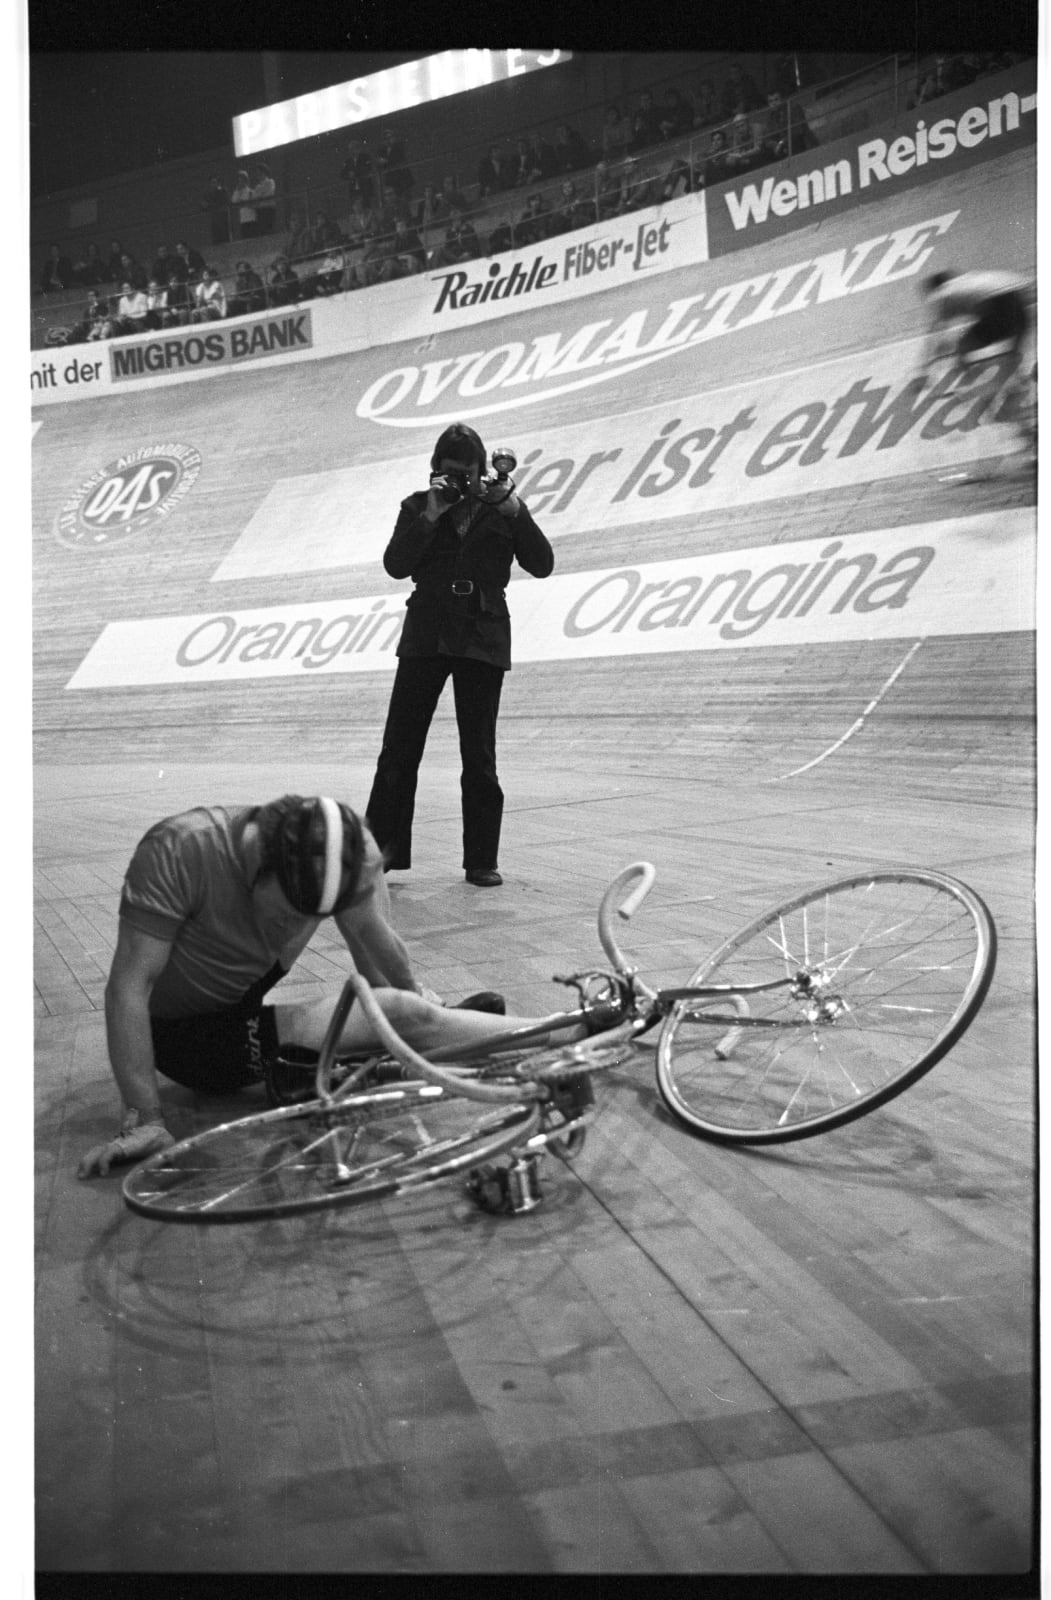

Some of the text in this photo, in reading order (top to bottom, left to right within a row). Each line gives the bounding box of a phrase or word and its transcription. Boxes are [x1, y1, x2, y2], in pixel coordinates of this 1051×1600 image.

[724, 92, 1036, 231] Wenn Reisen-
[355, 209, 960, 419] OVOMALTINE
[432, 217, 671, 315] Raichle Fiber-Jet
[64, 358, 102, 384] der
[113, 317, 308, 377] MIGROS BANK
[85, 464, 175, 524] DAS
[609, 405, 757, 505] ist
[176, 599, 408, 668] Orangin
[563, 541, 935, 640] Orangina
